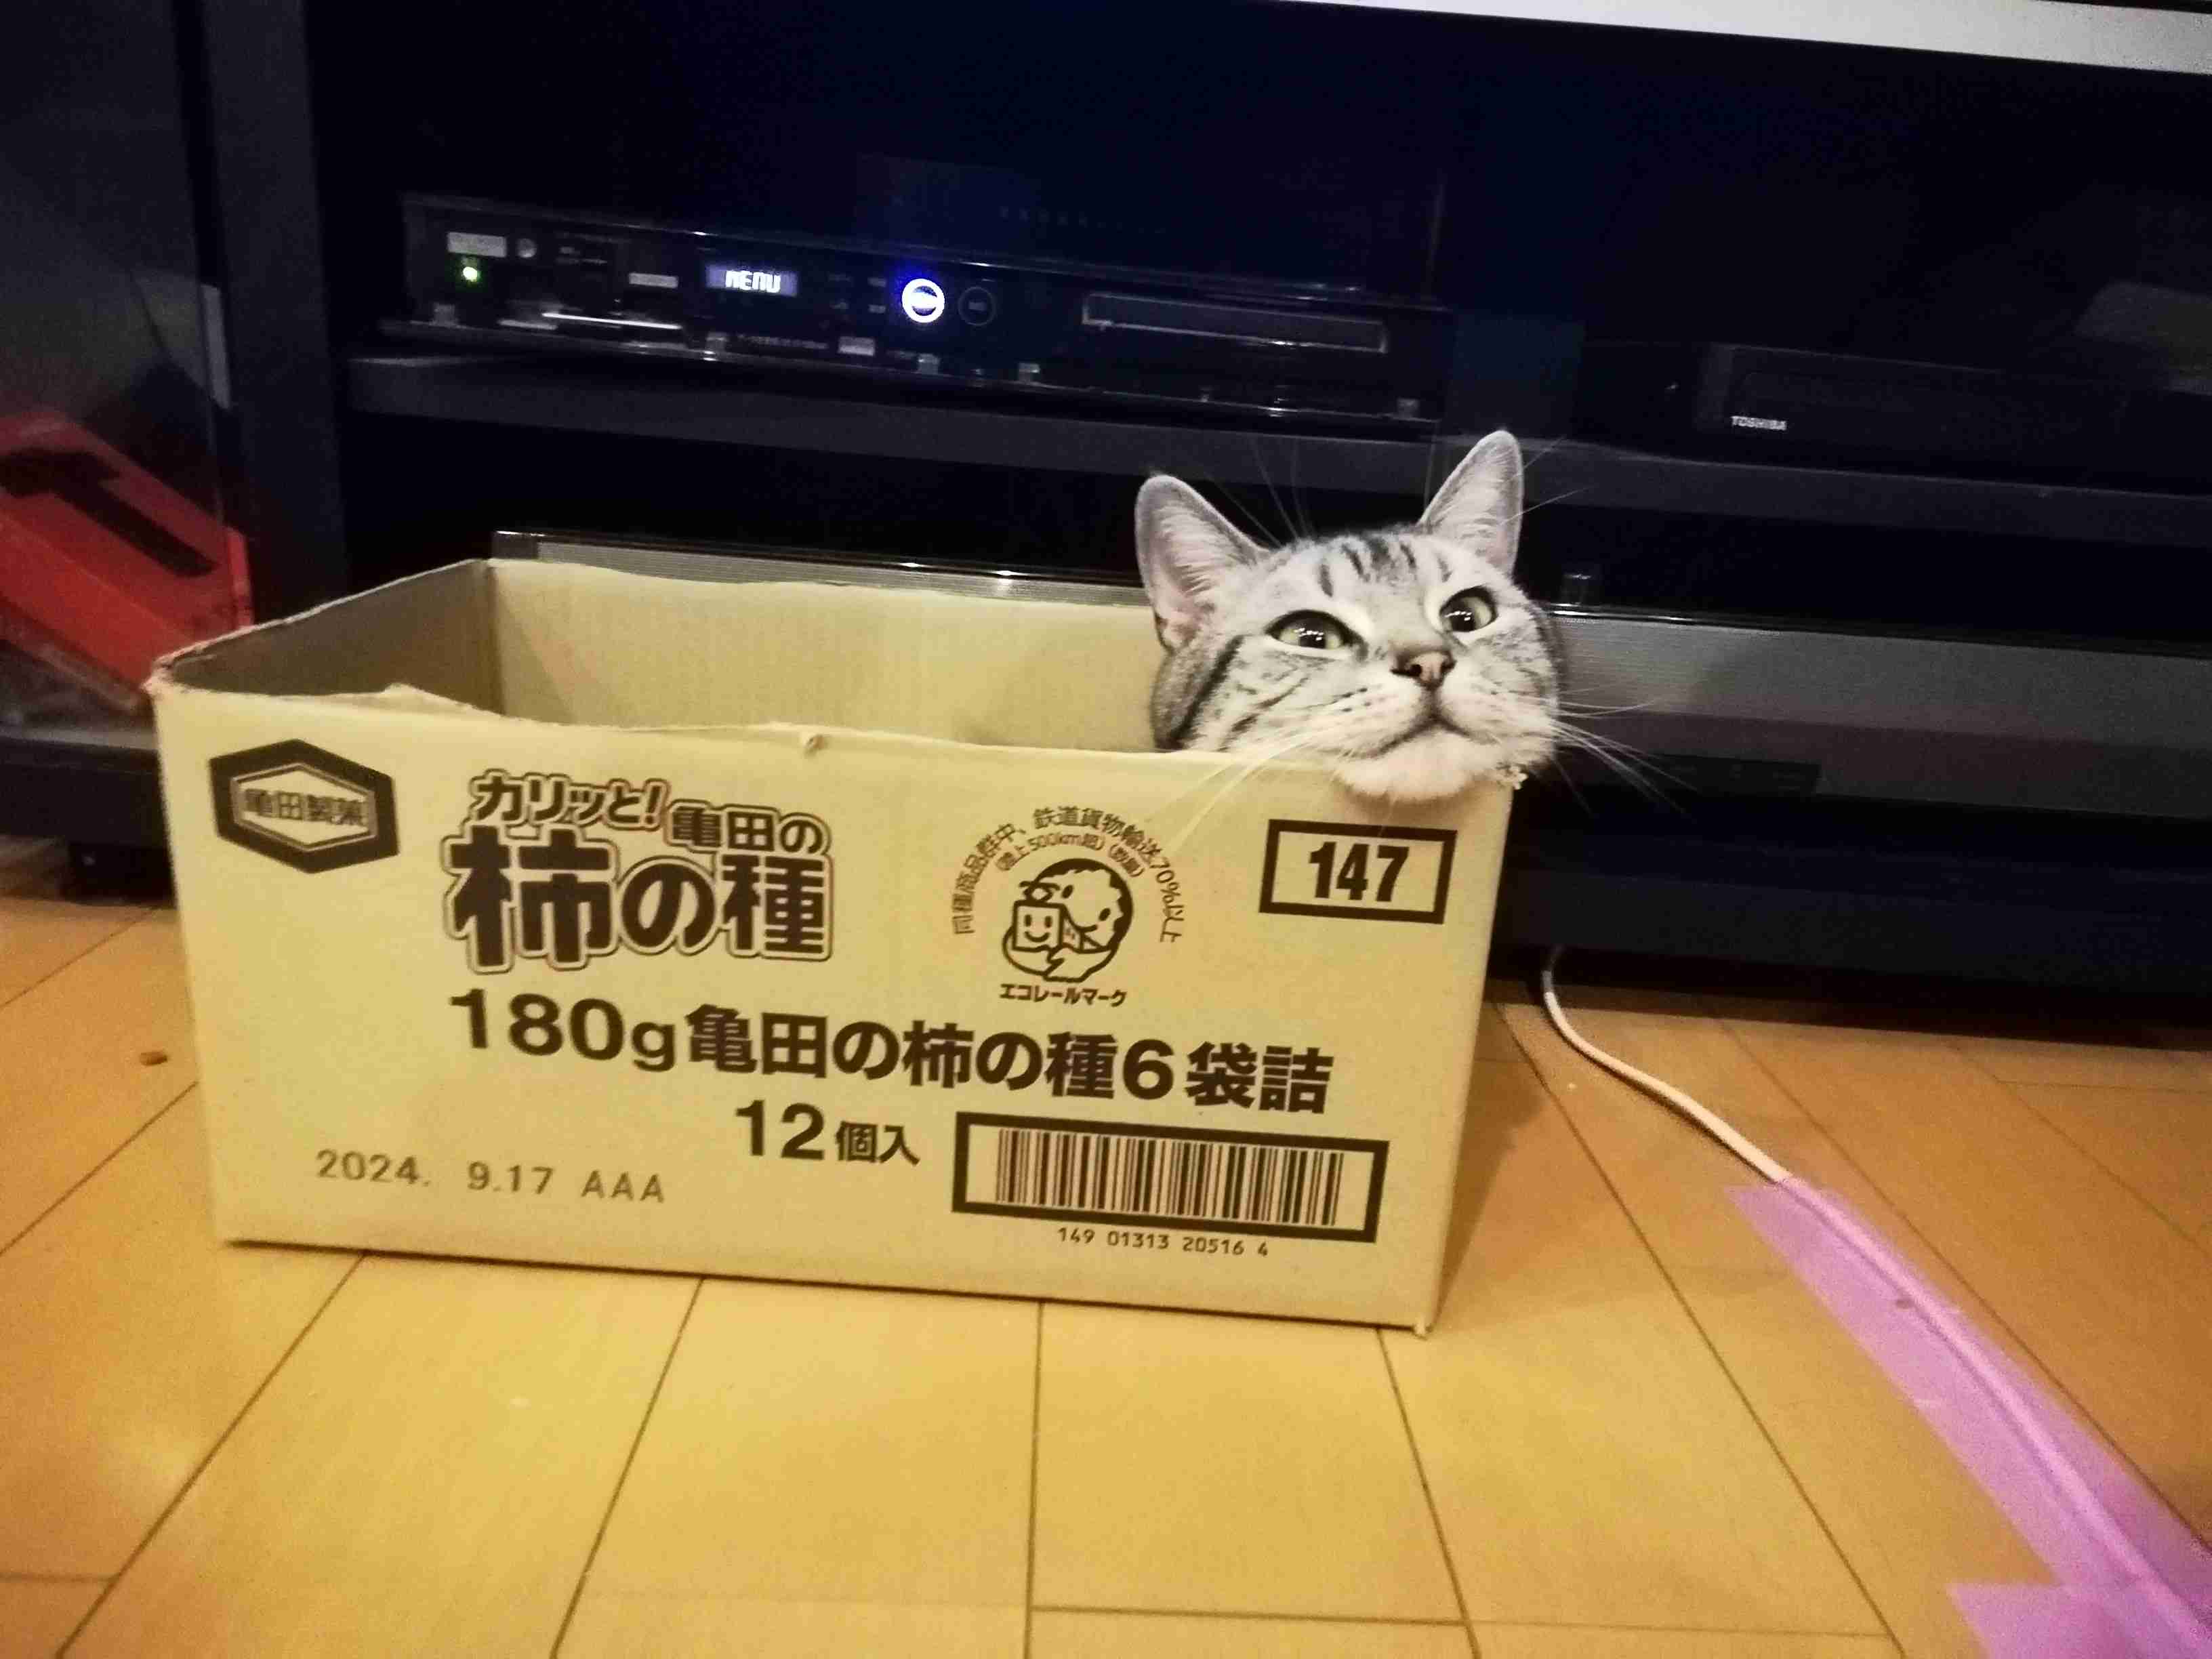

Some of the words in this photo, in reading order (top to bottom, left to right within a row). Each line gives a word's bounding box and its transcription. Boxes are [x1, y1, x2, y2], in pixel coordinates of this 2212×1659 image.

[1730, 415, 1787, 431] TOSHIBA
[473, 771, 668, 829] カリッと!
[670, 802, 828, 855] 亀田の
[443, 819, 830, 972] 柿の種
[1308, 841, 1412, 903] 147
[999, 983, 1128, 1008] エコレールマーク
[735, 1099, 921, 1167] 12個入
[315, 1148, 431, 1188] 2024.
[466, 1160, 555, 1195] 9.17
[580, 1170, 665, 1204] AAA
[1058, 1227, 1095, 1244] 149
[1107, 1230, 1170, 1250] 01313
[1182, 1236, 1244, 1256] 20516
[1257, 1242, 1269, 1256] 4
